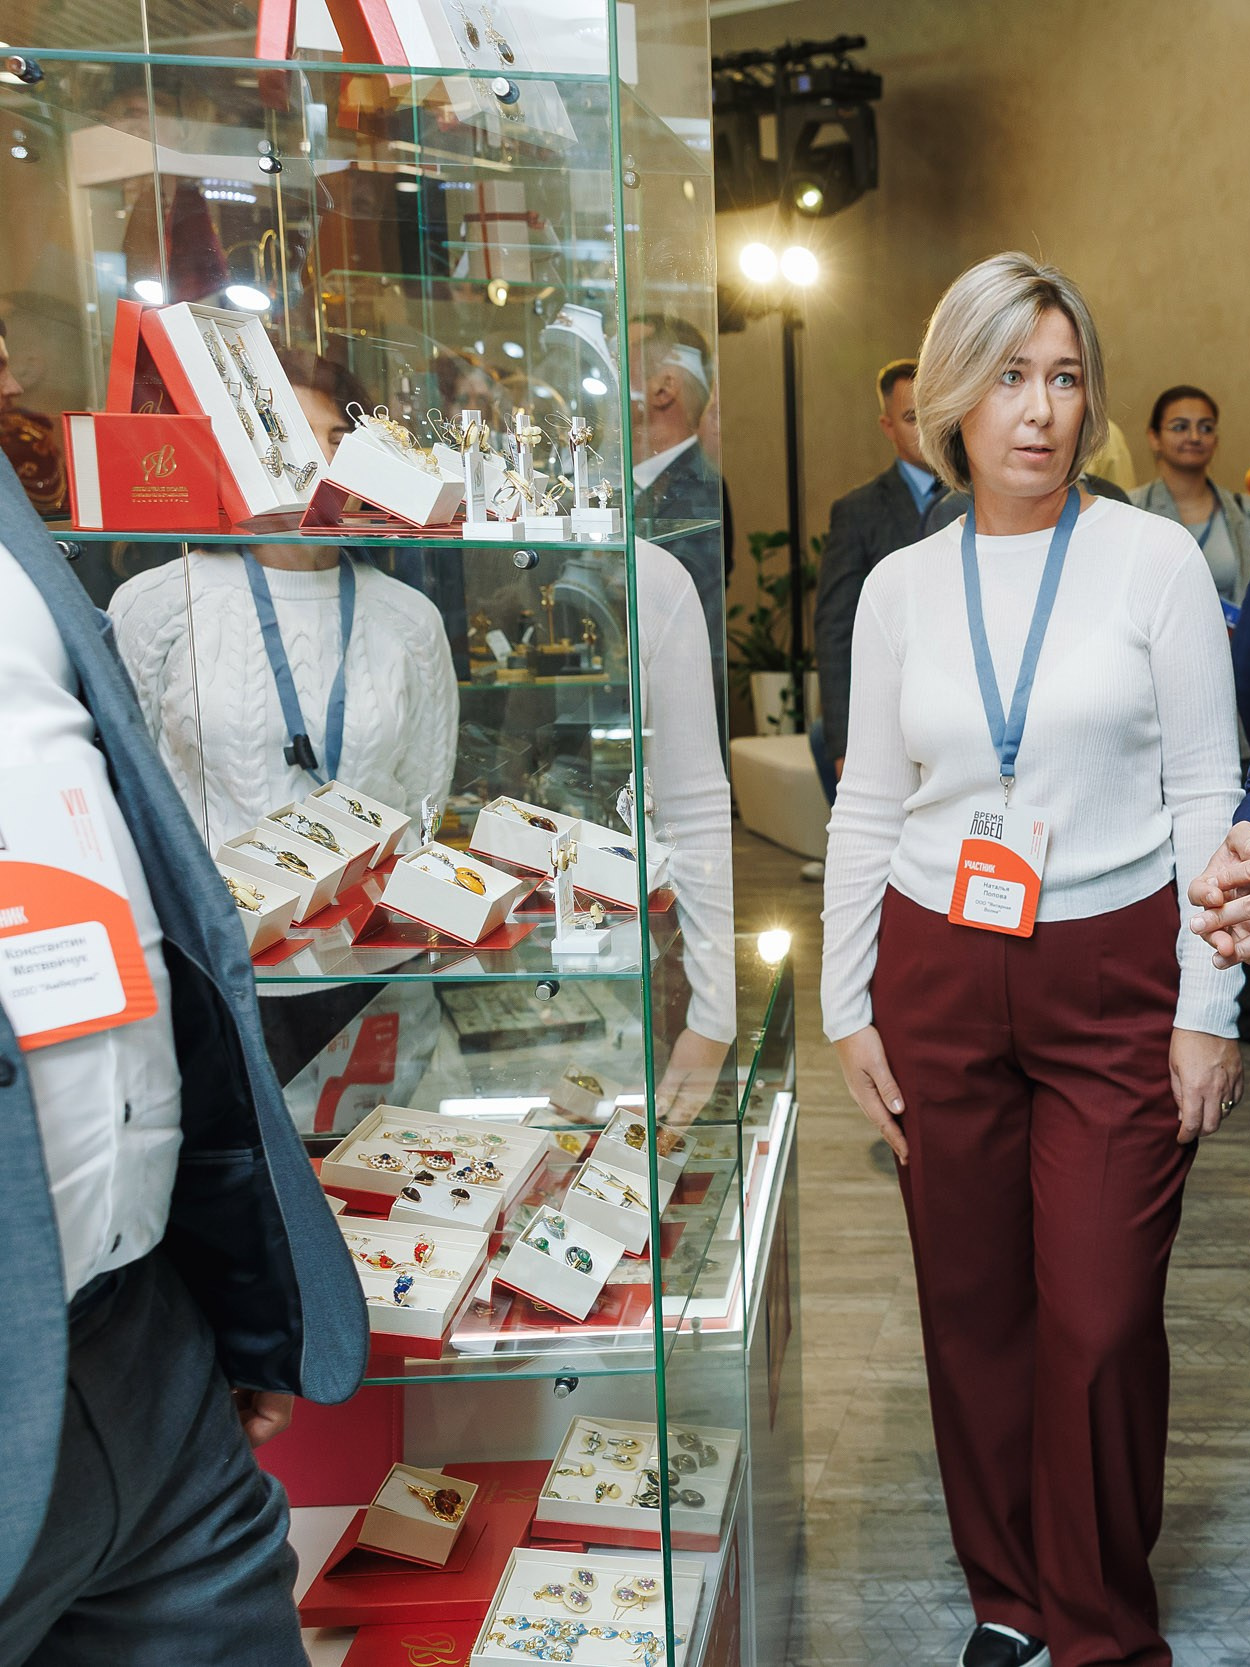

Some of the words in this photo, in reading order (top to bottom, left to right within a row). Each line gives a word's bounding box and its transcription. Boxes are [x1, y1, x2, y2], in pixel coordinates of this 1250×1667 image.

[974, 811, 1003, 823] ВРЕМЯ
[970, 819, 1003, 840] ПОБЕД
[1033, 820, 1044, 836] VII
[964, 860, 995, 873] УЧАСТНИК
[983, 882, 1010, 891] Наталья
[984, 890, 1007, 899] Попова
[4, 936, 87, 959] Константин
